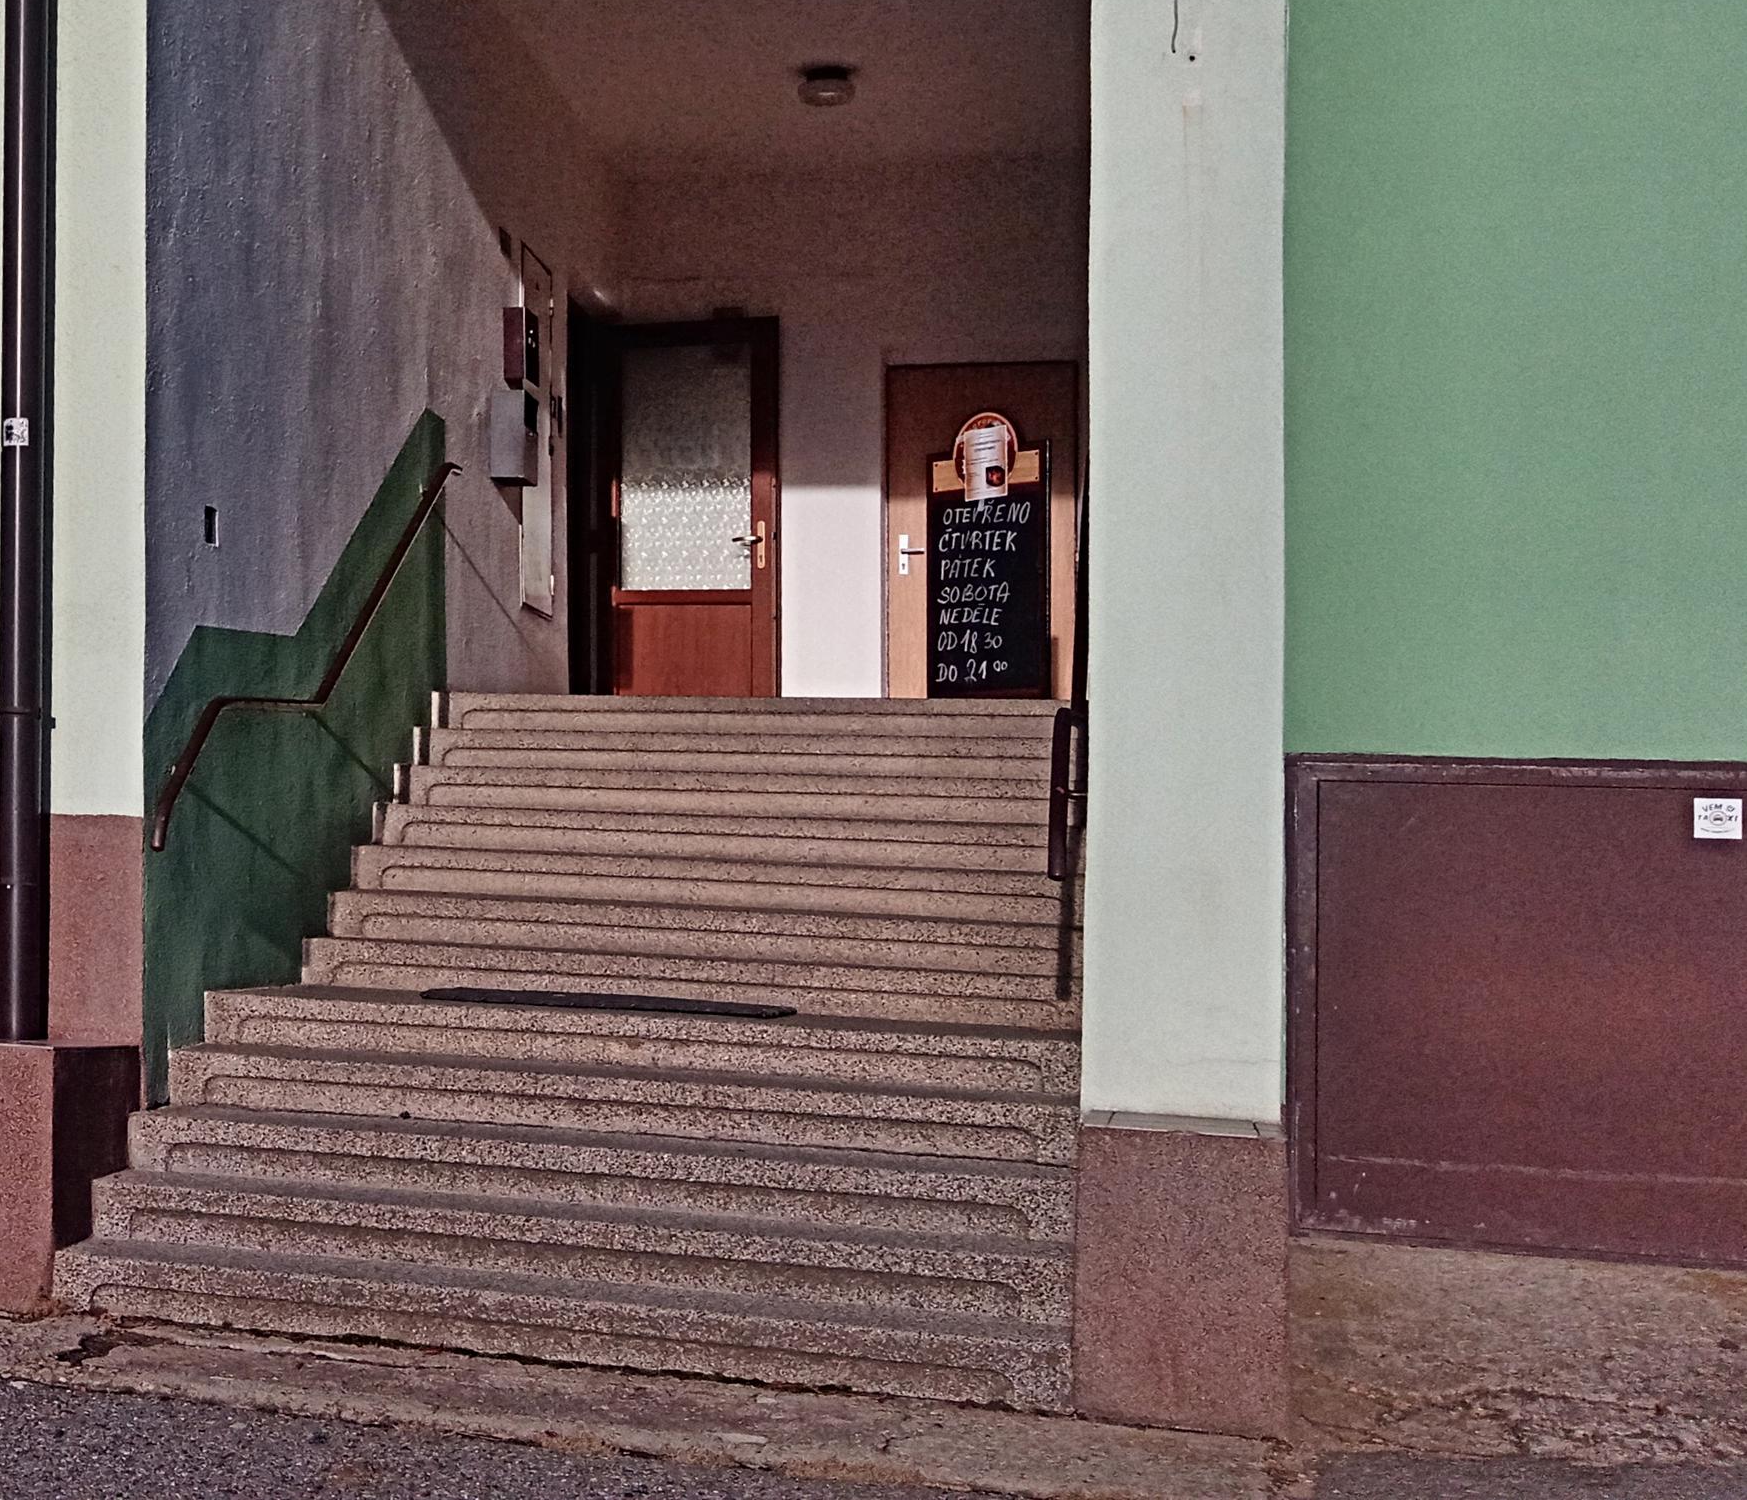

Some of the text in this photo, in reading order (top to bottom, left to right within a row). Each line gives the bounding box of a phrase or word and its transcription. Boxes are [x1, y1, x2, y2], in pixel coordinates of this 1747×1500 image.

[942, 500, 1031, 525] OTEVŘENO
[938, 528, 1018, 553] ČTVRTEK
[937, 581, 1011, 604] SOBOTA
[937, 629, 1003, 654] OD 18 30
[935, 658, 1009, 683] DO 21 00
